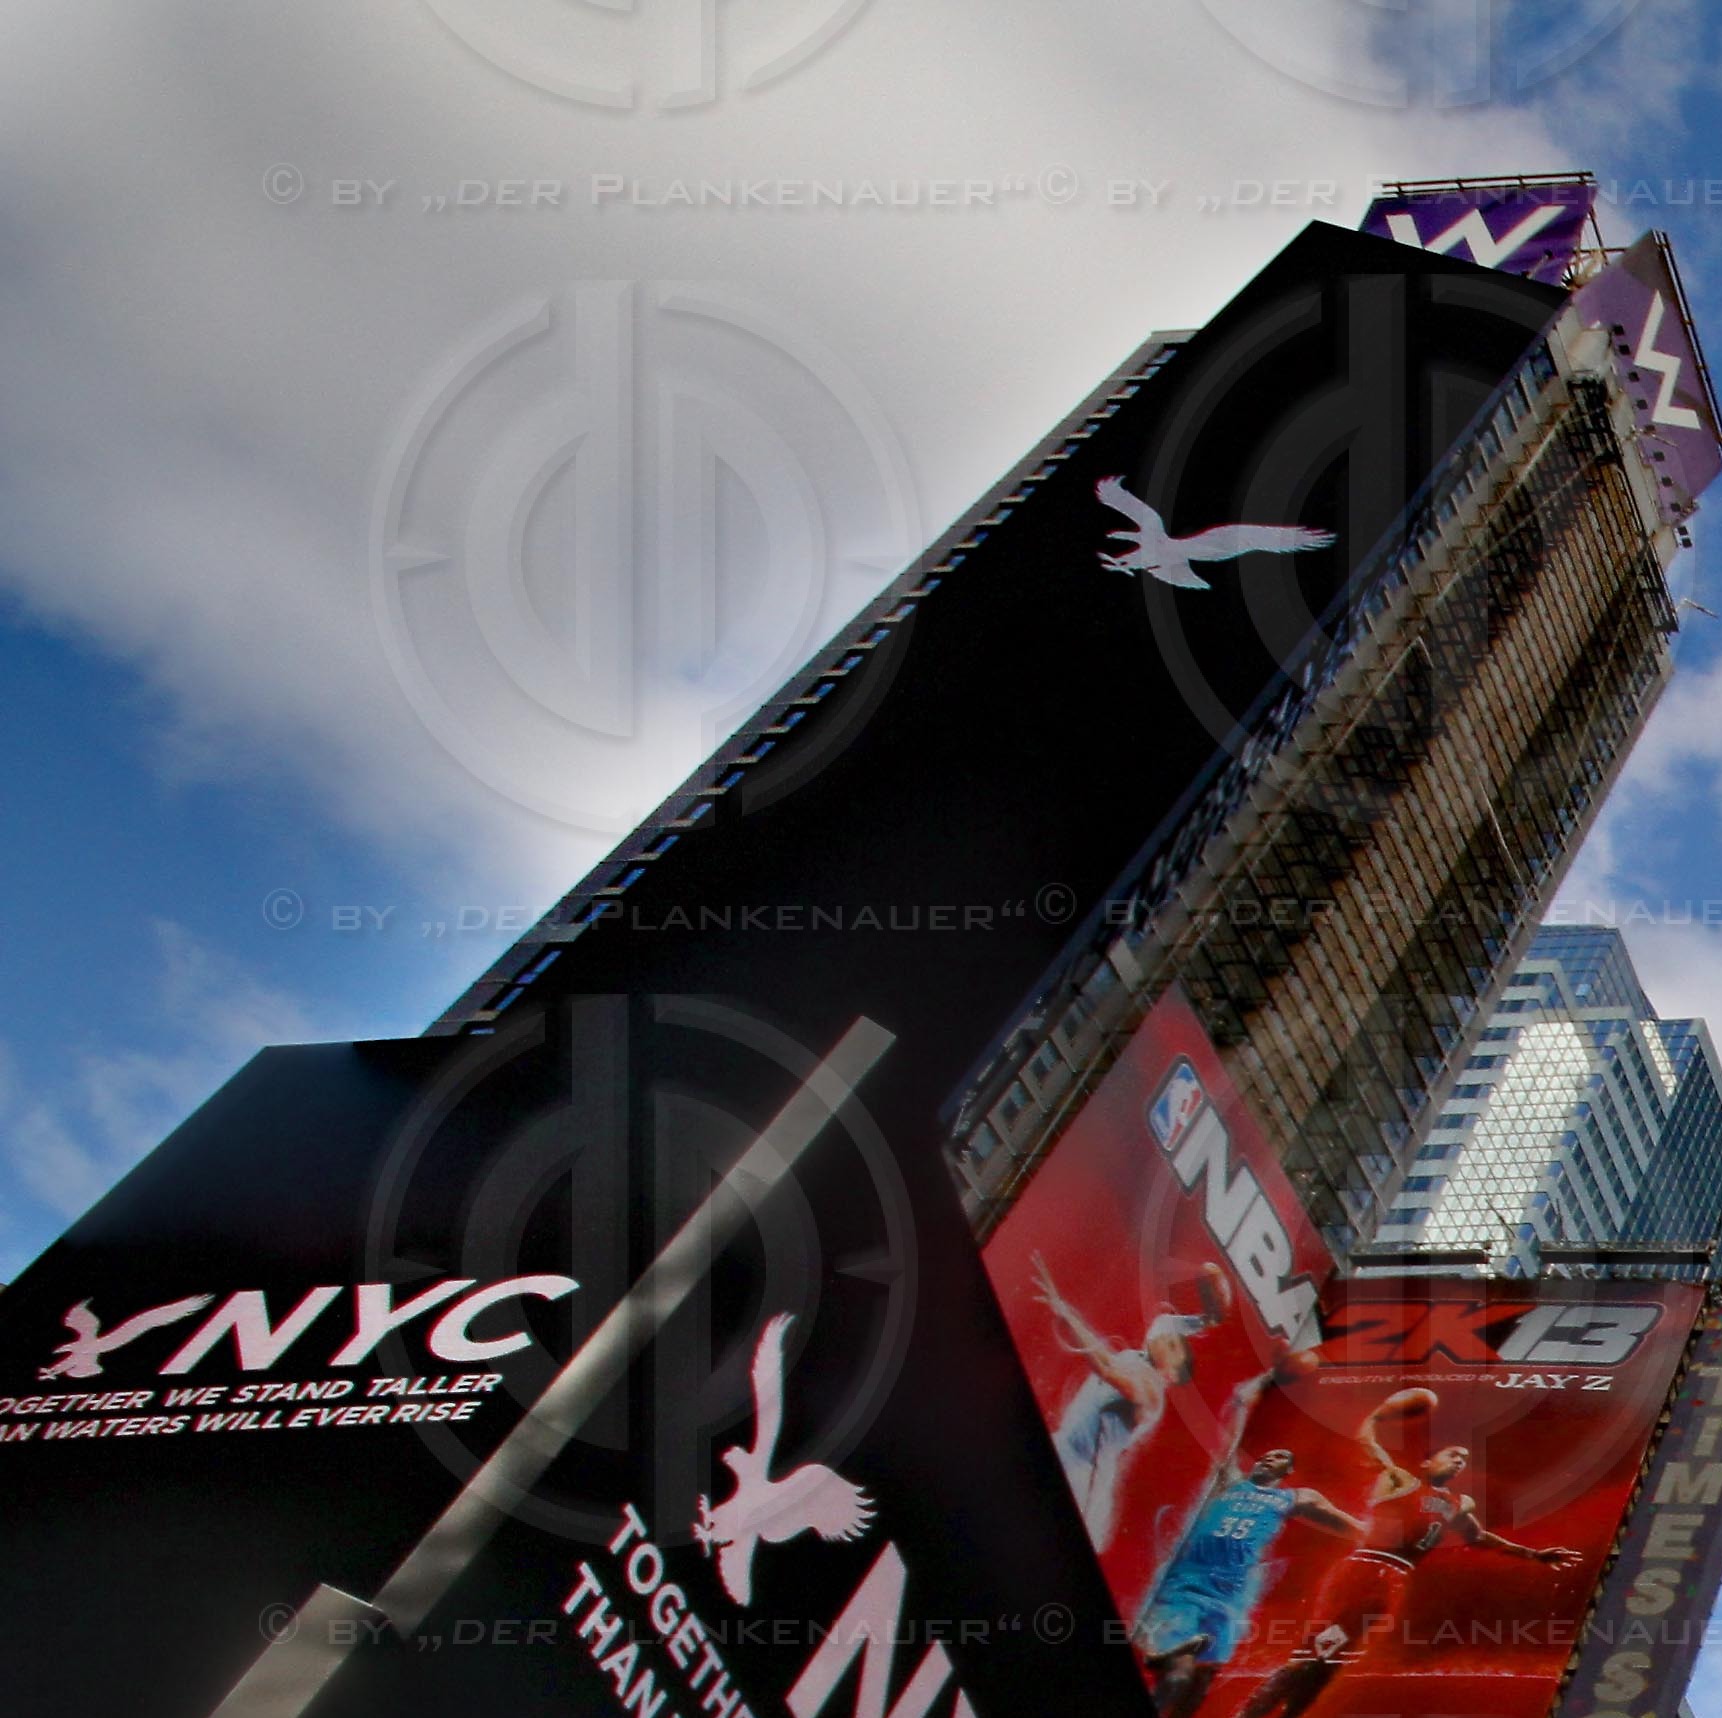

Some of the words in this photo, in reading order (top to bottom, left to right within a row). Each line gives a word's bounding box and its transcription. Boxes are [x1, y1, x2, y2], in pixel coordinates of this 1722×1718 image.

[1173, 1109, 1323, 1350] NBA
[1320, 1301, 1663, 1363] 2K13
[160, 1275, 581, 1375] NYC
[165, 1387, 228, 1407] WE
[232, 1379, 354, 1404] STAND
[370, 1373, 502, 1397] TALLER
[1495, 1372, 1572, 1390] JAY
[1581, 1374, 1613, 1391] Z
[43, 1415, 191, 1440] WATERS
[194, 1409, 282, 1432] WILL
[287, 1405, 389, 1428] EVER
[388, 1401, 479, 1423] RISE
